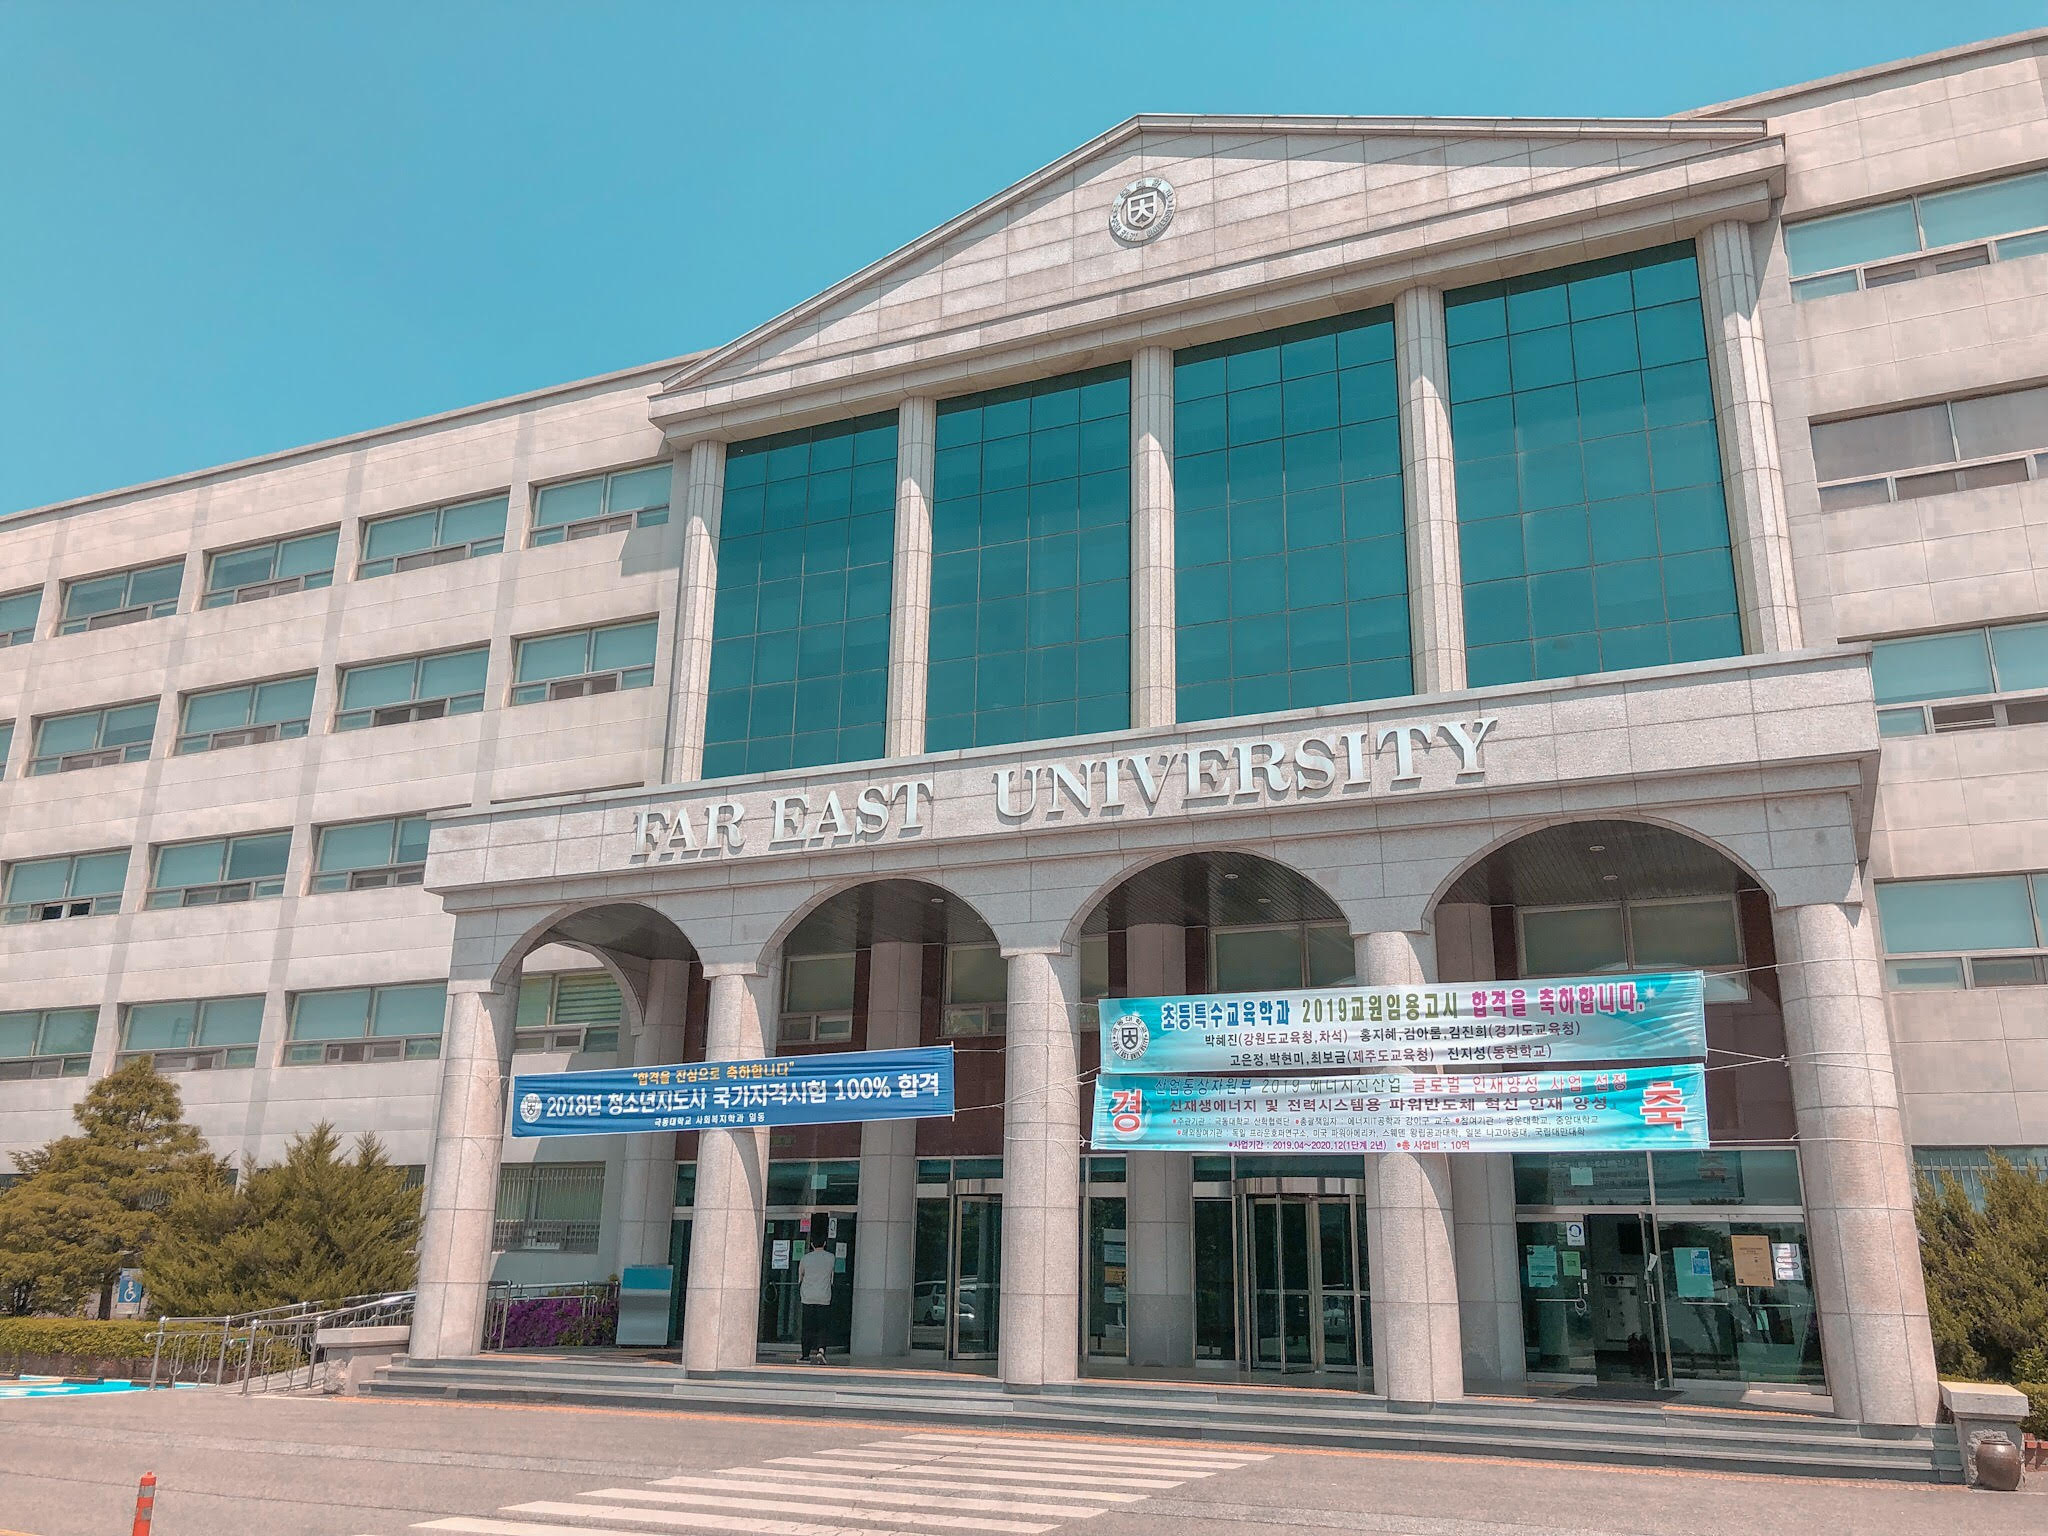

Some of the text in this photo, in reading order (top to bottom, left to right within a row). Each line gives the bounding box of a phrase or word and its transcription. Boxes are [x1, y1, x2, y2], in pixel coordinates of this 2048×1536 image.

[632, 717, 1498, 855] FAR EAST UNIVERSITY
[1162, 999, 1290, 1030] 초등특수교육학과
[1302, 992, 1458, 1023] 2019교원임용고시
[1472, 989, 1527, 1018] 합격을
[1539, 984, 1643, 1015] 축하합니다.
[1205, 1028, 1349, 1048] 박혜진(강원도교육청,차석)
[1447, 1043, 1552, 1061] 진지성(동현학교)
[676, 1067, 720, 1083] 진심으로
[1261, 1078, 1300, 1094] 2019
[1310, 1077, 1400, 1094] 에너지신산업
[1412, 1076, 1460, 1094] 글로벌
[1472, 1076, 1539, 1094] 인재양성
[1550, 1074, 1581, 1092] 사업
[1594, 1073, 1627, 1091] 선정
[546, 1094, 602, 1117] 2018년
[608, 1087, 706, 1115] 청소년지도사
[713, 1080, 827, 1109] 국가자격시험
[834, 1076, 892, 1101] 100%
[898, 1072, 939, 1098] 합격
[1265, 1099, 1278, 1112] 및
[1288, 1098, 1380, 1112] 전력시스템용
[1389, 1097, 1475, 1112] 파워반도체
[1485, 1097, 1519, 1111] 혁신
[1529, 1096, 1563, 1111] 인재
[1111, 1089, 1142, 1132] 경
[1641, 1081, 1687, 1130] 축
[749, 1111, 765, 1123] 일동
[1435, 1116, 1451, 1126] 교수
[1233, 1140, 1264, 1150] 사업기간
[1414, 1140, 1439, 1150] 사업비
[1451, 1140, 1470, 1150] 10억
